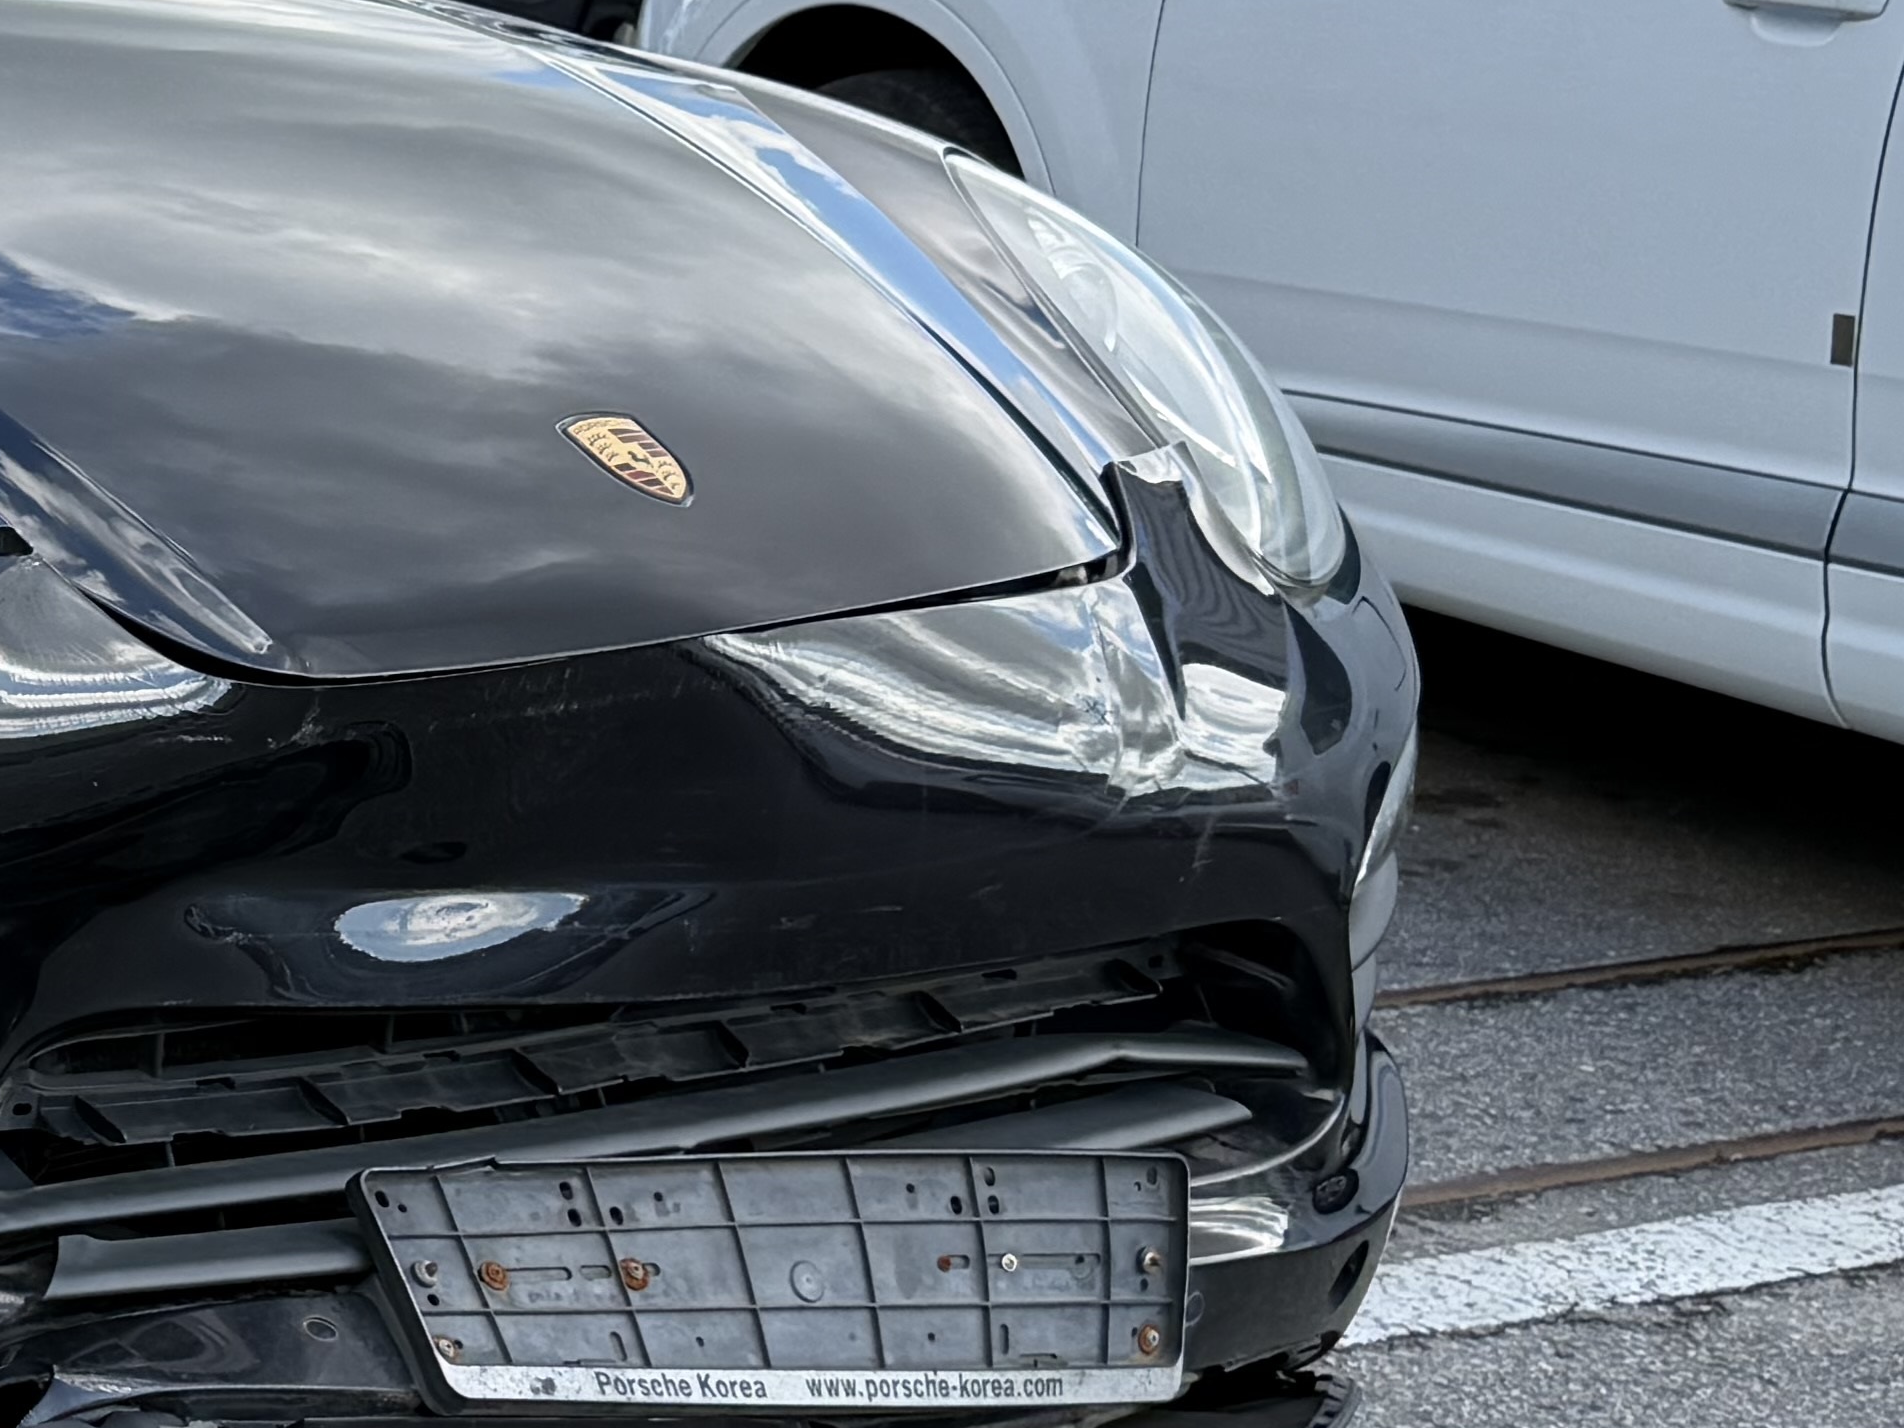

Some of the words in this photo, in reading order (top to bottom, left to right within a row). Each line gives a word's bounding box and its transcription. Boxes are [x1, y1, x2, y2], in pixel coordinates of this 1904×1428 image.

[594, 1372, 692, 1398] Porsche
[698, 1374, 768, 1399] Korea
[805, 1374, 1064, 1401] www.porsche-korea.com
